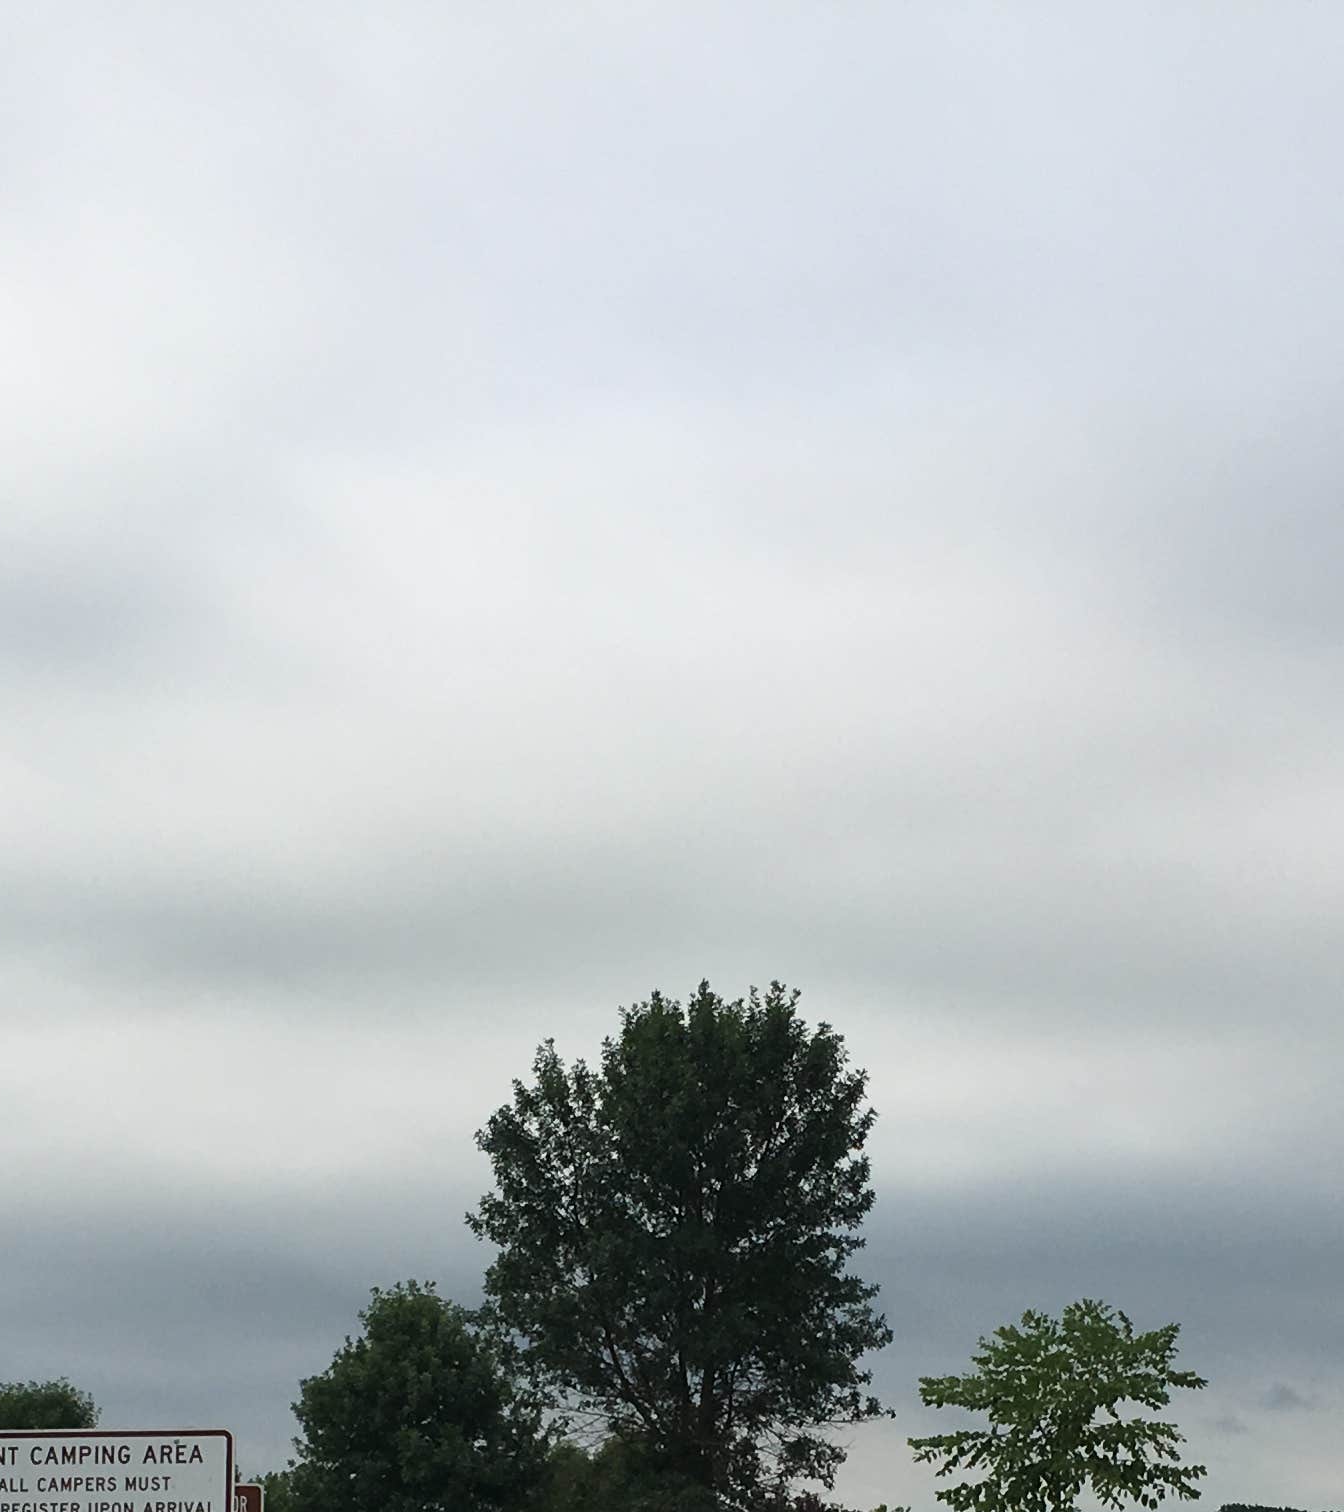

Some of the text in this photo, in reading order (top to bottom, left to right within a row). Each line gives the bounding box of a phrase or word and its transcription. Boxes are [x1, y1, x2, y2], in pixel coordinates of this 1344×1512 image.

[30, 1446, 131, 1465] CAMPING
[143, 1445, 204, 1464] AREA
[37, 1477, 117, 1492] CAMPERS
[125, 1476, 171, 1491] MUST
